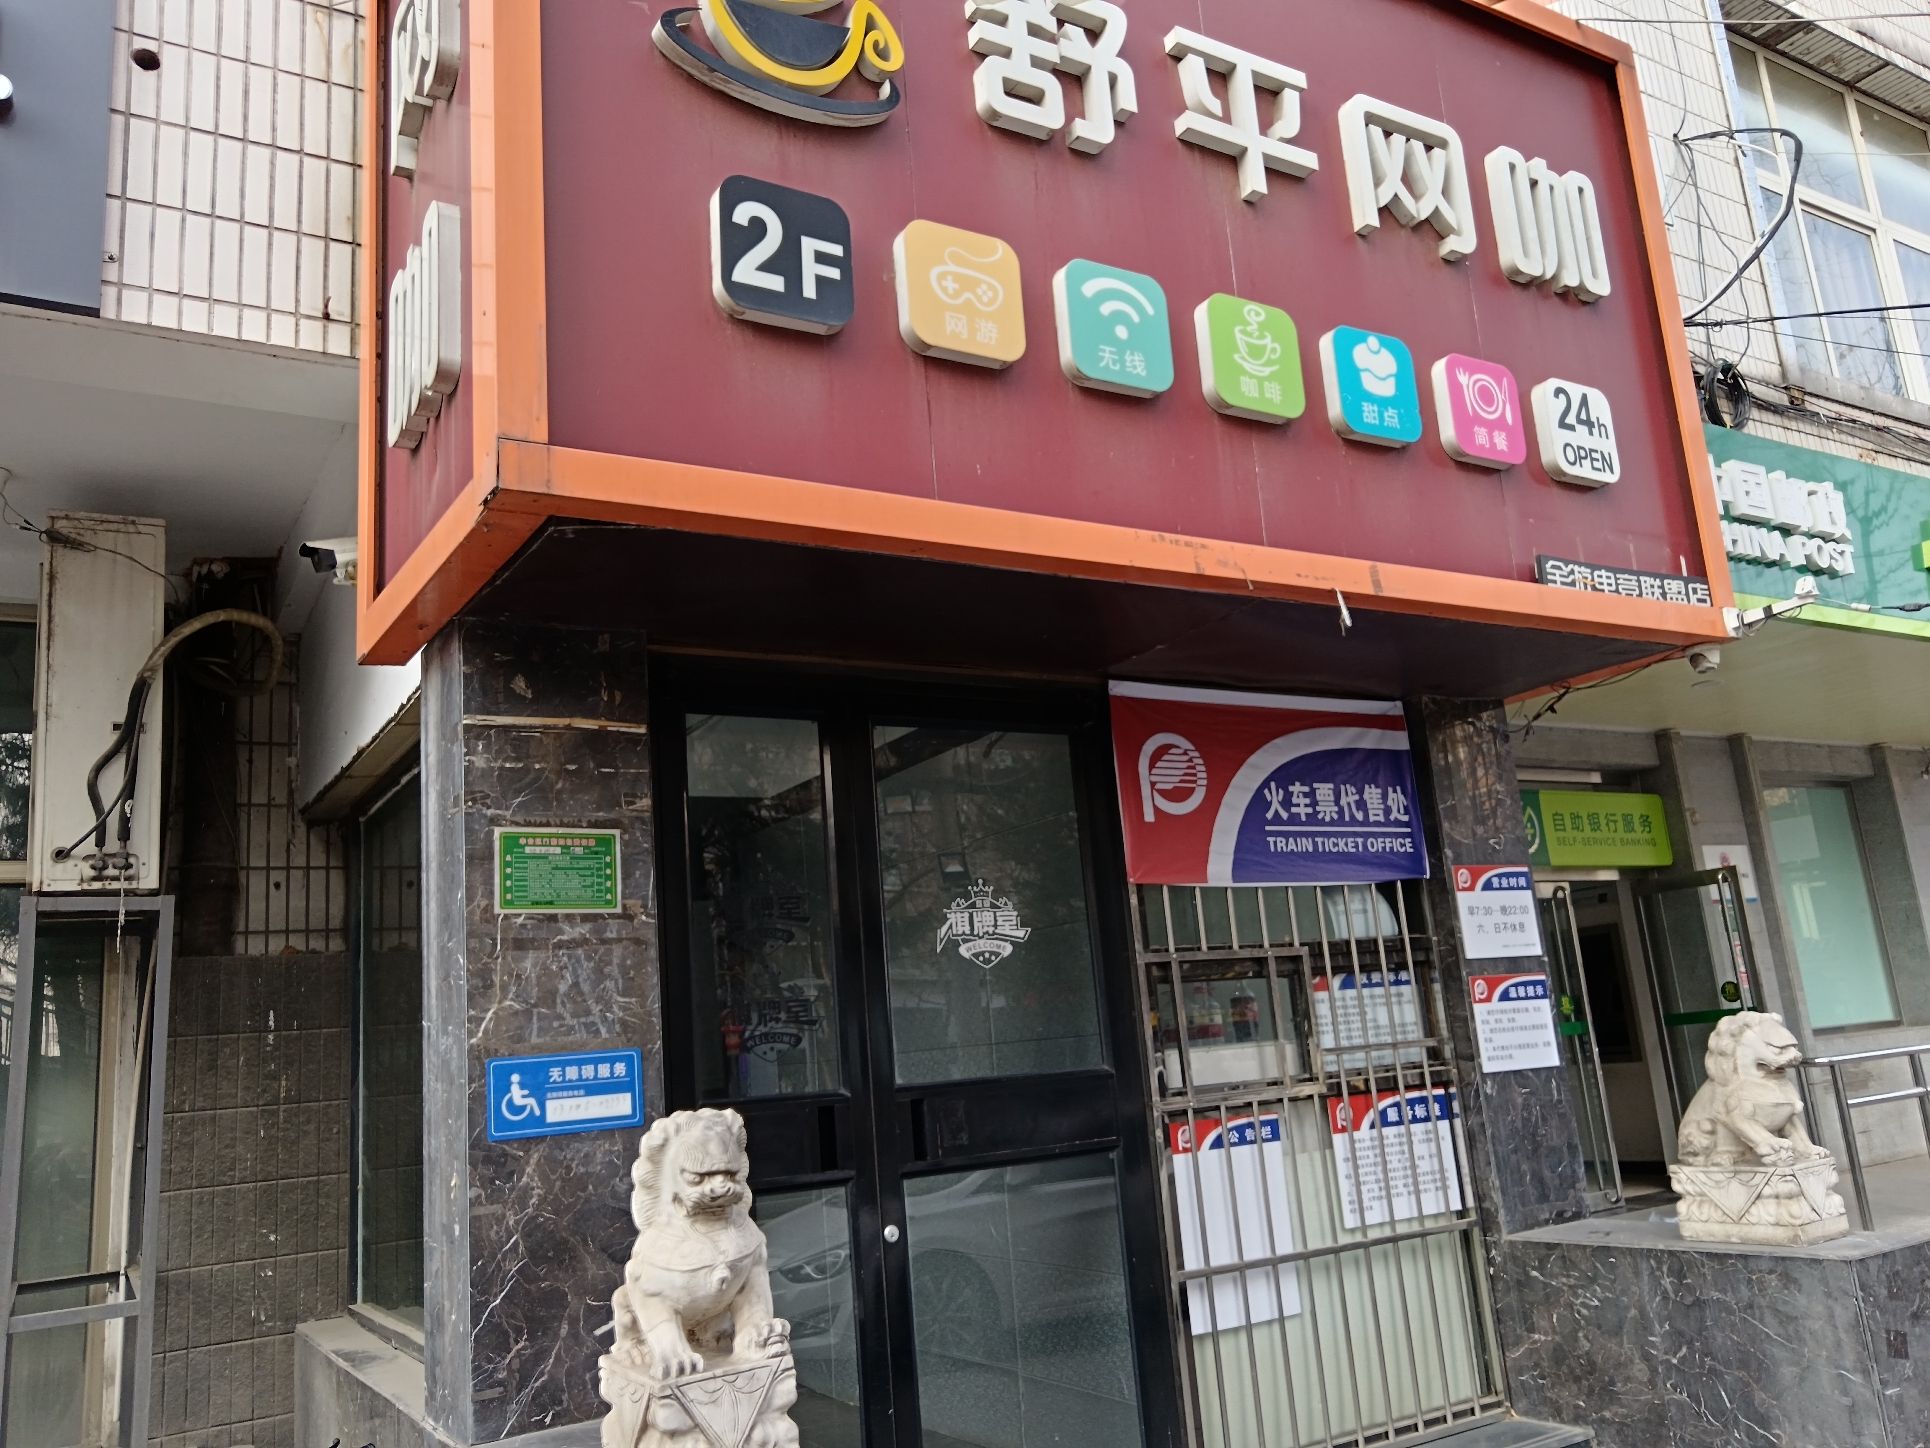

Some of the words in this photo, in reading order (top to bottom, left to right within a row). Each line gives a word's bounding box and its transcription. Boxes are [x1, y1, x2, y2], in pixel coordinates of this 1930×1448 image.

[965, 0, 1611, 302] 舒平网咖
[731, 200, 844, 300] 2F
[944, 310, 1000, 345] 网游
[1098, 345, 1147, 377] 无线
[1239, 374, 1283, 404] 咖啡
[1361, 401, 1400, 430] 甜点
[1553, 386, 1609, 440] 24h
[1473, 425, 1510, 452] 简餐
[1563, 442, 1615, 476] OPEN
[1785, 534, 1855, 577] POST
[1264, 780, 1410, 823] 火车票代售处
[1552, 810, 1653, 834] 自助银行服务
[1266, 836, 1313, 853] TRAIN
[1314, 837, 1364, 853] TICKET
[1366, 837, 1414, 854] OFFICE
[1556, 836, 1617, 847] SELF-SERVICE
[1620, 837, 1657, 848] BANKING
[1491, 876, 1528, 888] 营业时间
[946, 910, 1026, 938] 棋牌室
[964, 941, 1008, 954] WELCOME
[549, 1061, 626, 1083] 无障碍服务
[1229, 1126, 1273, 1143] 公告栏
